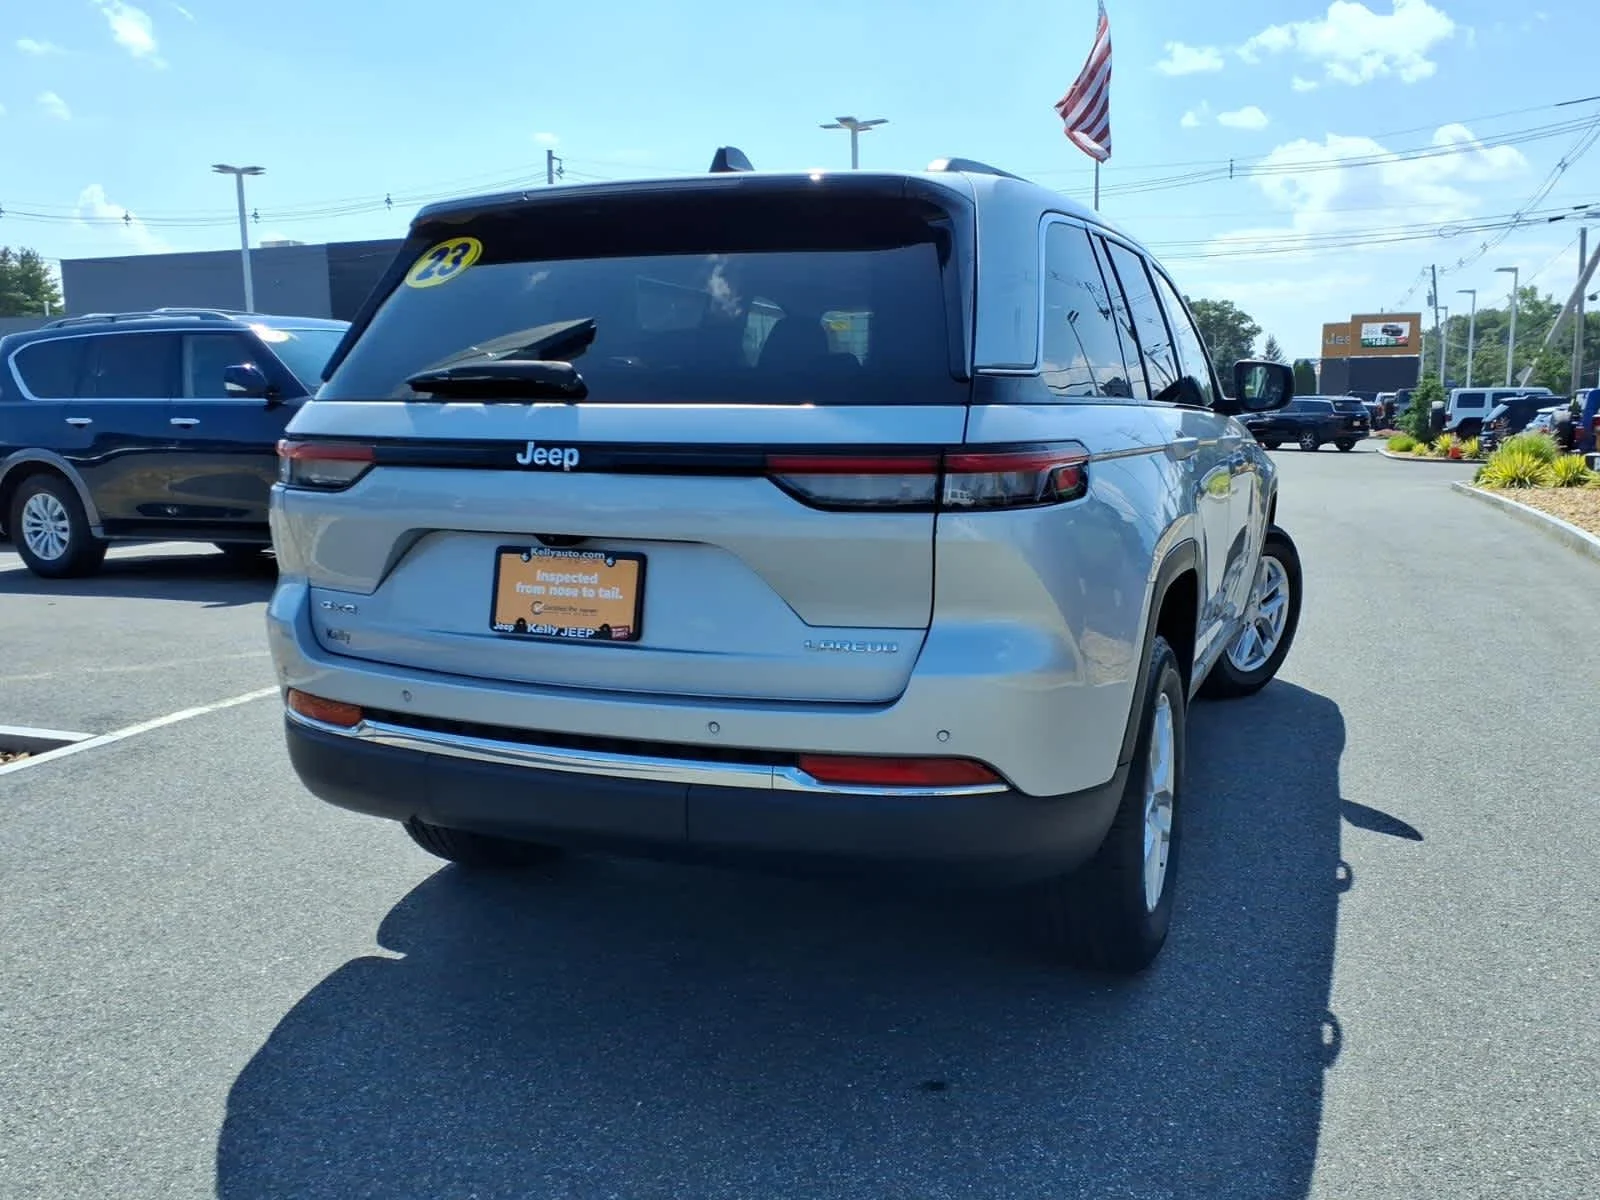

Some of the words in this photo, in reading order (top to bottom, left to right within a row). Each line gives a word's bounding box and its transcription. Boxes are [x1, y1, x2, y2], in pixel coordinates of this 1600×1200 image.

[415, 243, 472, 281] 23
[516, 441, 579, 471] Jeep
[530, 547, 605, 560] Kellyauto.com
[536, 570, 598, 585] Inspected
[516, 582, 545, 595] from
[549, 585, 578, 597] nose
[582, 586, 595, 598] to
[599, 587, 623, 600] tail.
[493, 622, 515, 633] Jeep
[527, 624, 558, 636] Kelly
[560, 627, 595, 638] JEEP
